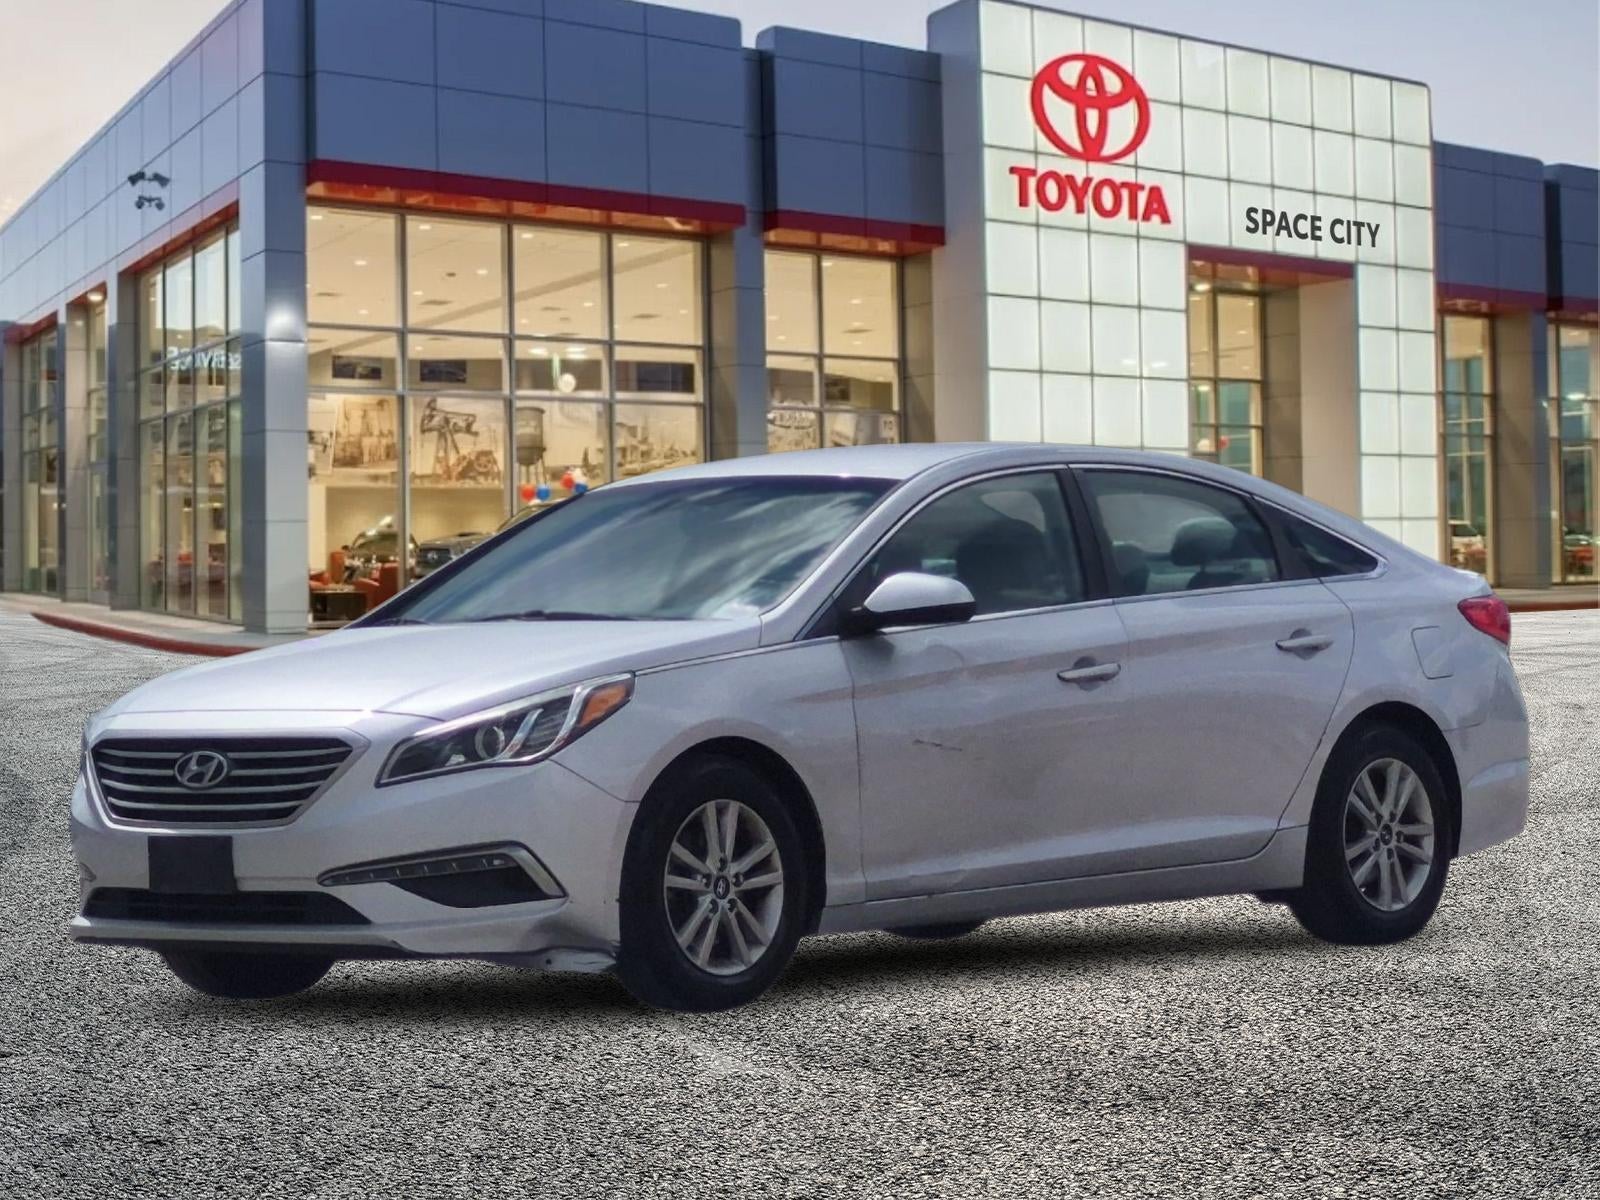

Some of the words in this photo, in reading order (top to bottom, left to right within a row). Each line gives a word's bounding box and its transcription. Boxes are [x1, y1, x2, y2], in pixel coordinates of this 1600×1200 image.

[1009, 166, 1171, 225] TOYOTA
[1245, 206, 1323, 242] SPACE
[1329, 218, 1381, 248] CITY
